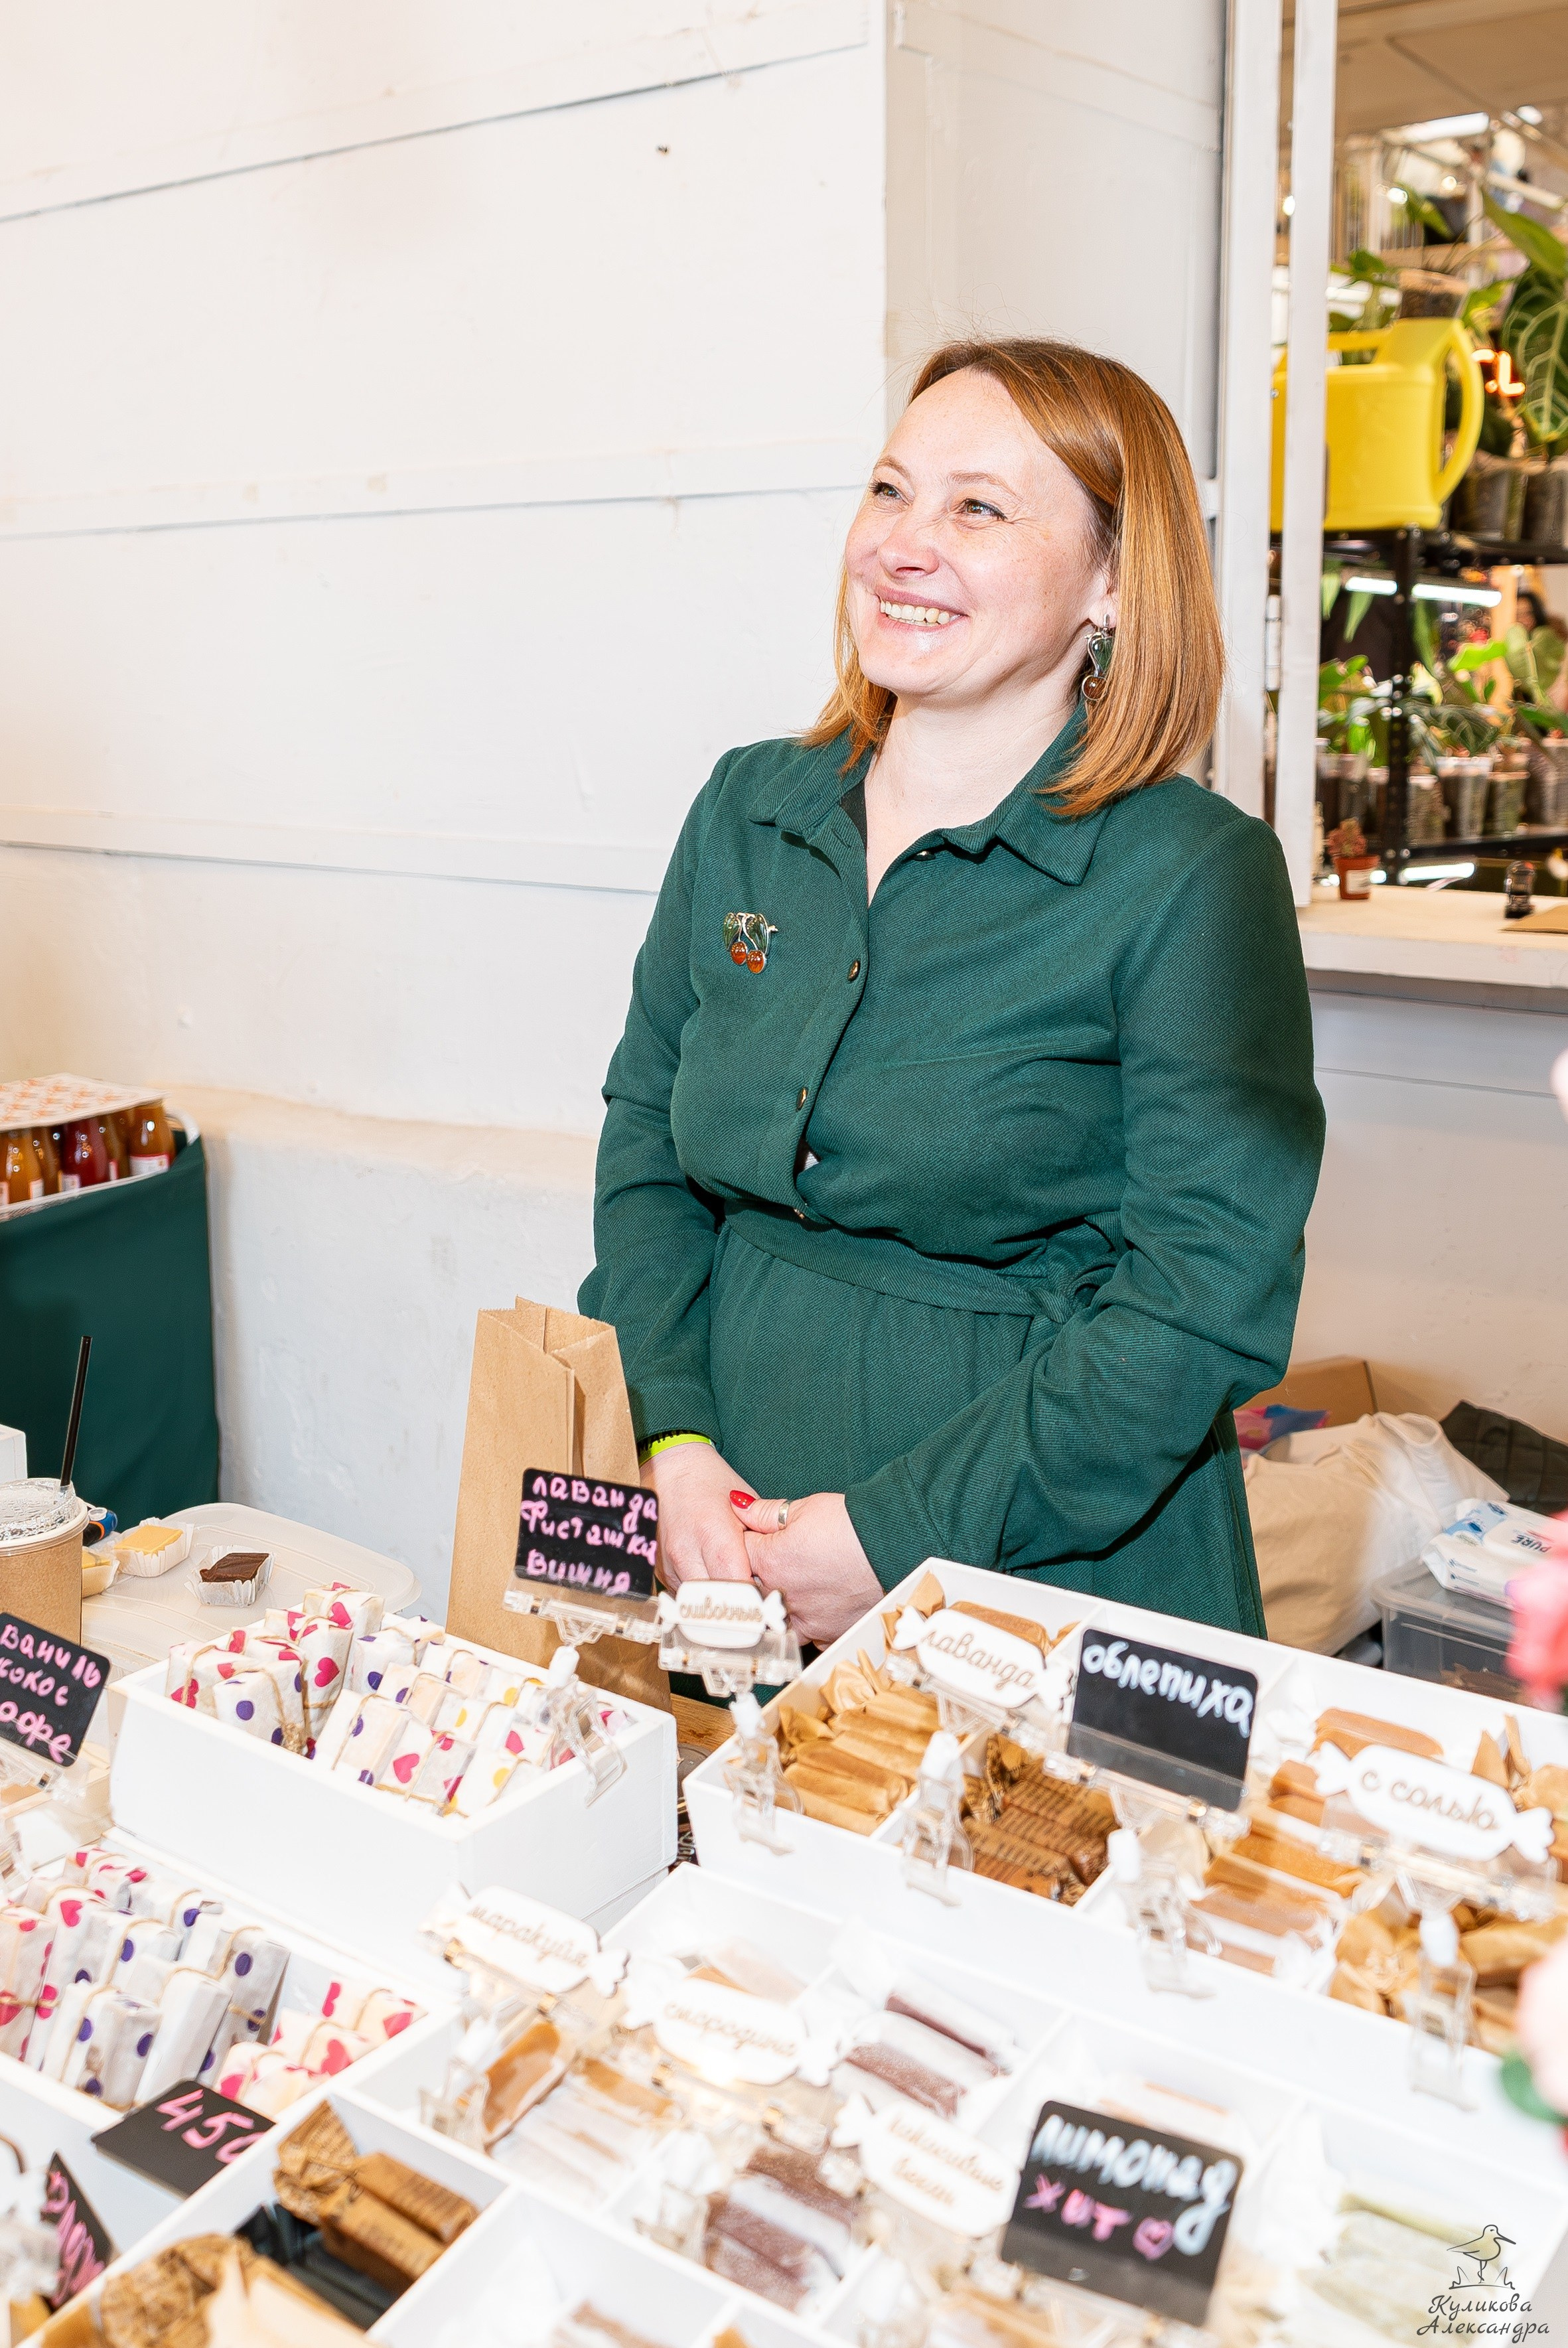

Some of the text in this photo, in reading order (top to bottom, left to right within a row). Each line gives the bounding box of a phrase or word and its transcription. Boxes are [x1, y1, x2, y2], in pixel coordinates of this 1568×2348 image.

[533, 1476, 658, 1534] лаванда
[1511, 1534, 1552, 1553] PURE
[920, 1629, 1036, 1691] лаванда
[1082, 1641, 1254, 1738] облепиха
[0, 1700, 71, 1763] офе
[1391, 1781, 1500, 1830] солью
[466, 1905, 588, 1968] маракуйя
[1031, 2114, 1240, 2256] лимонад
